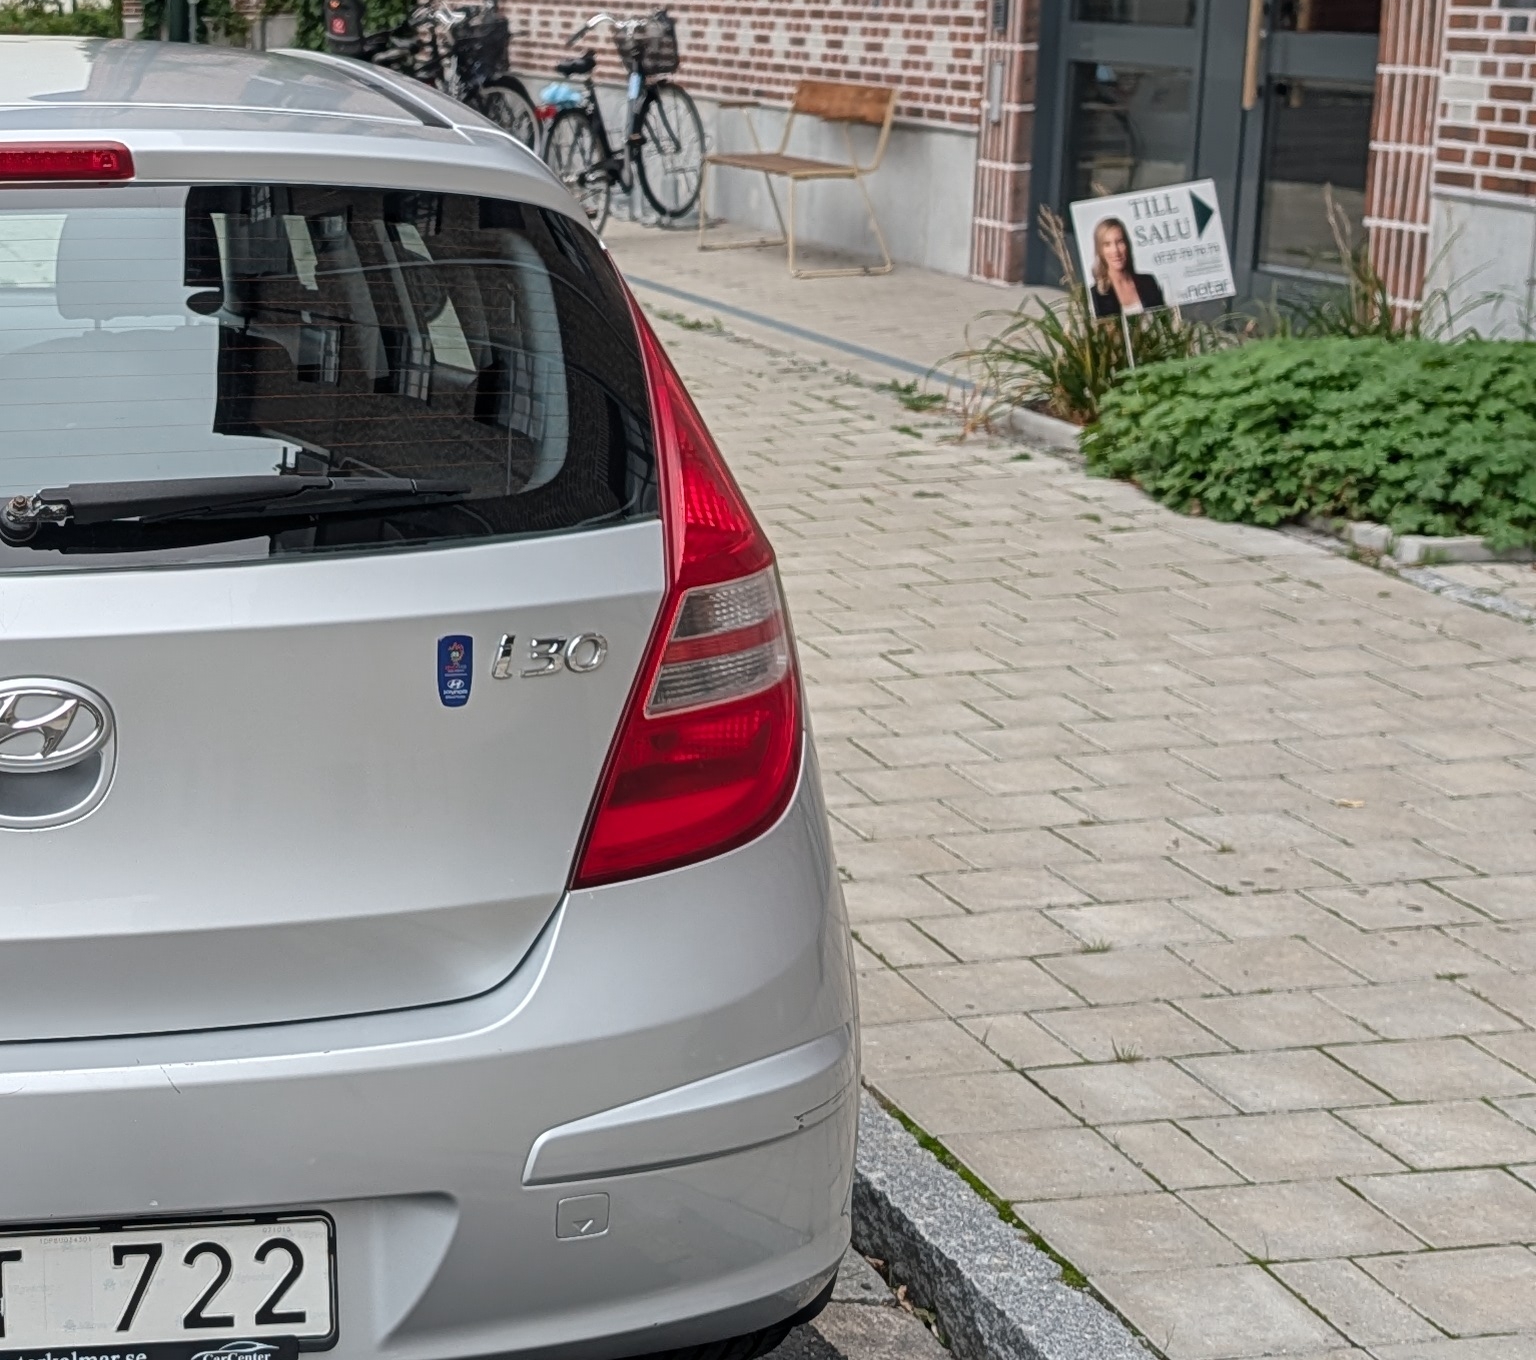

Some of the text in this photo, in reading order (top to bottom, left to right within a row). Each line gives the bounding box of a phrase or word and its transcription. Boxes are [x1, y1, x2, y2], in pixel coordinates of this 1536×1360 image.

[1130, 194, 1179, 219] TILL
[1135, 218, 1191, 247] SALU
[491, 632, 608, 680] i30
[113, 1237, 306, 1332] 722
